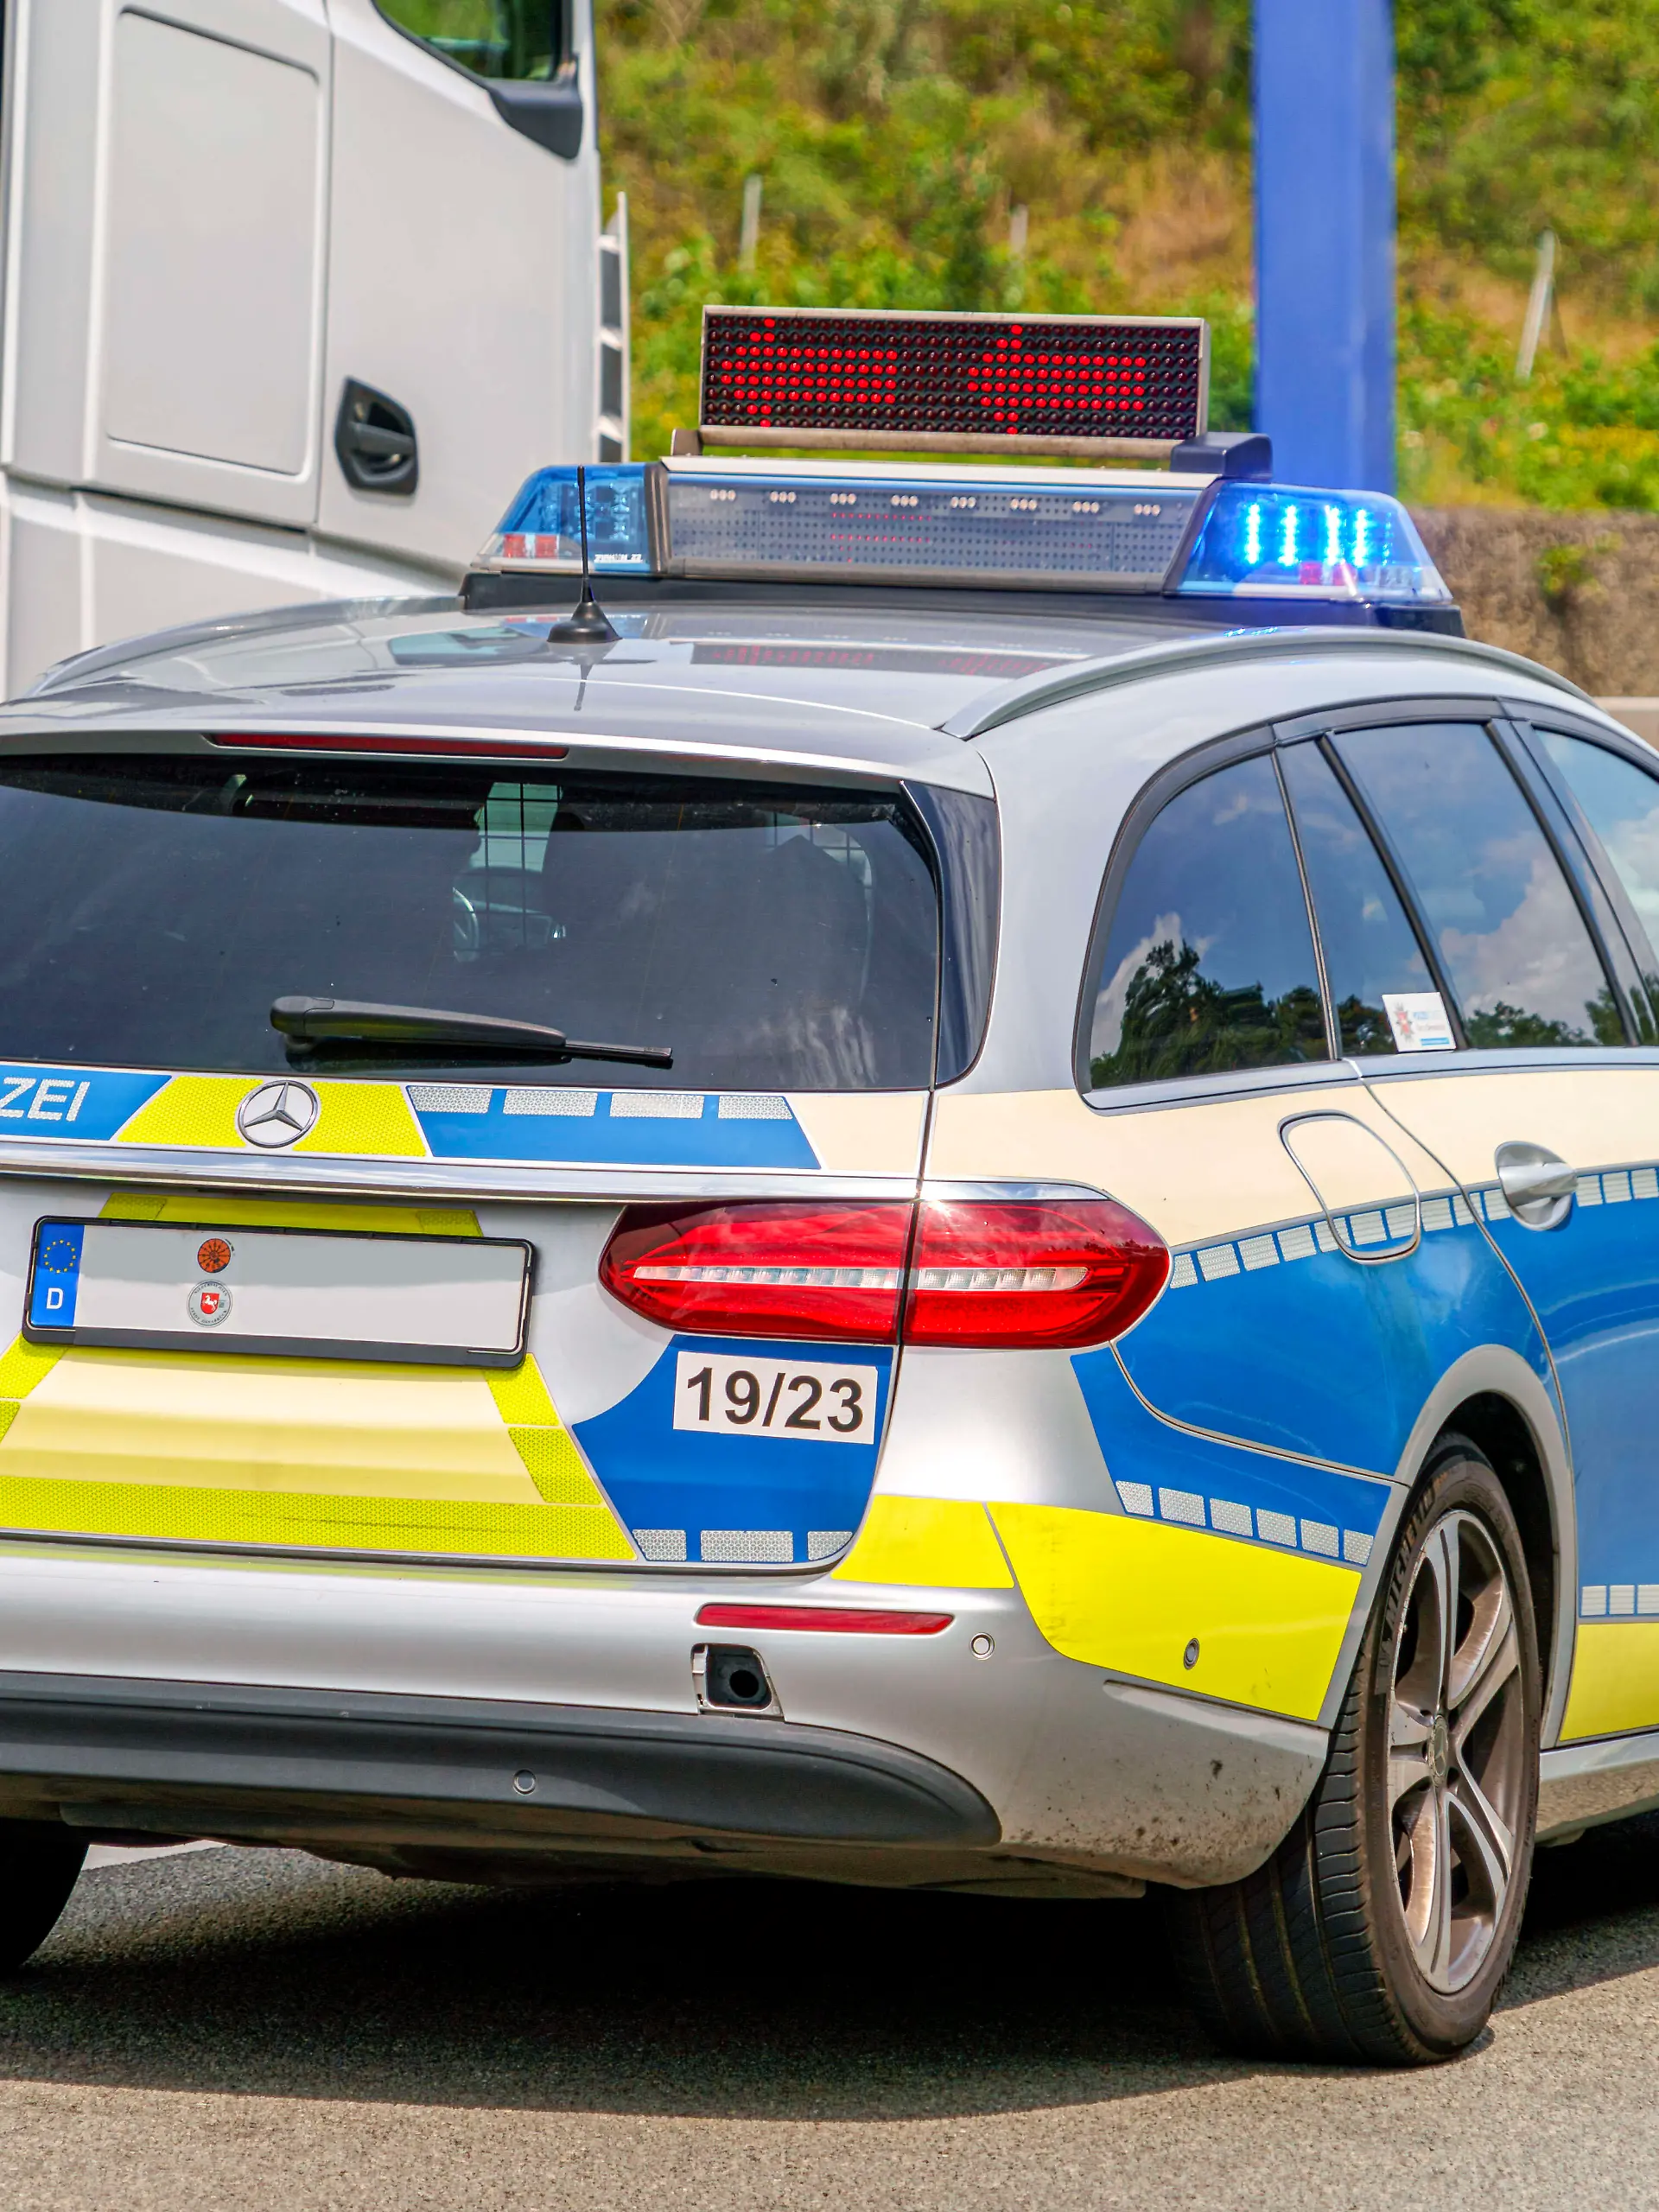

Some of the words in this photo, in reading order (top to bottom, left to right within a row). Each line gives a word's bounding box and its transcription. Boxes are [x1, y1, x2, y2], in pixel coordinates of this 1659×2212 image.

[0, 1077, 91, 1122] ZEI
[46, 1287, 64, 1310] D
[687, 1366, 864, 1433] 19/23
